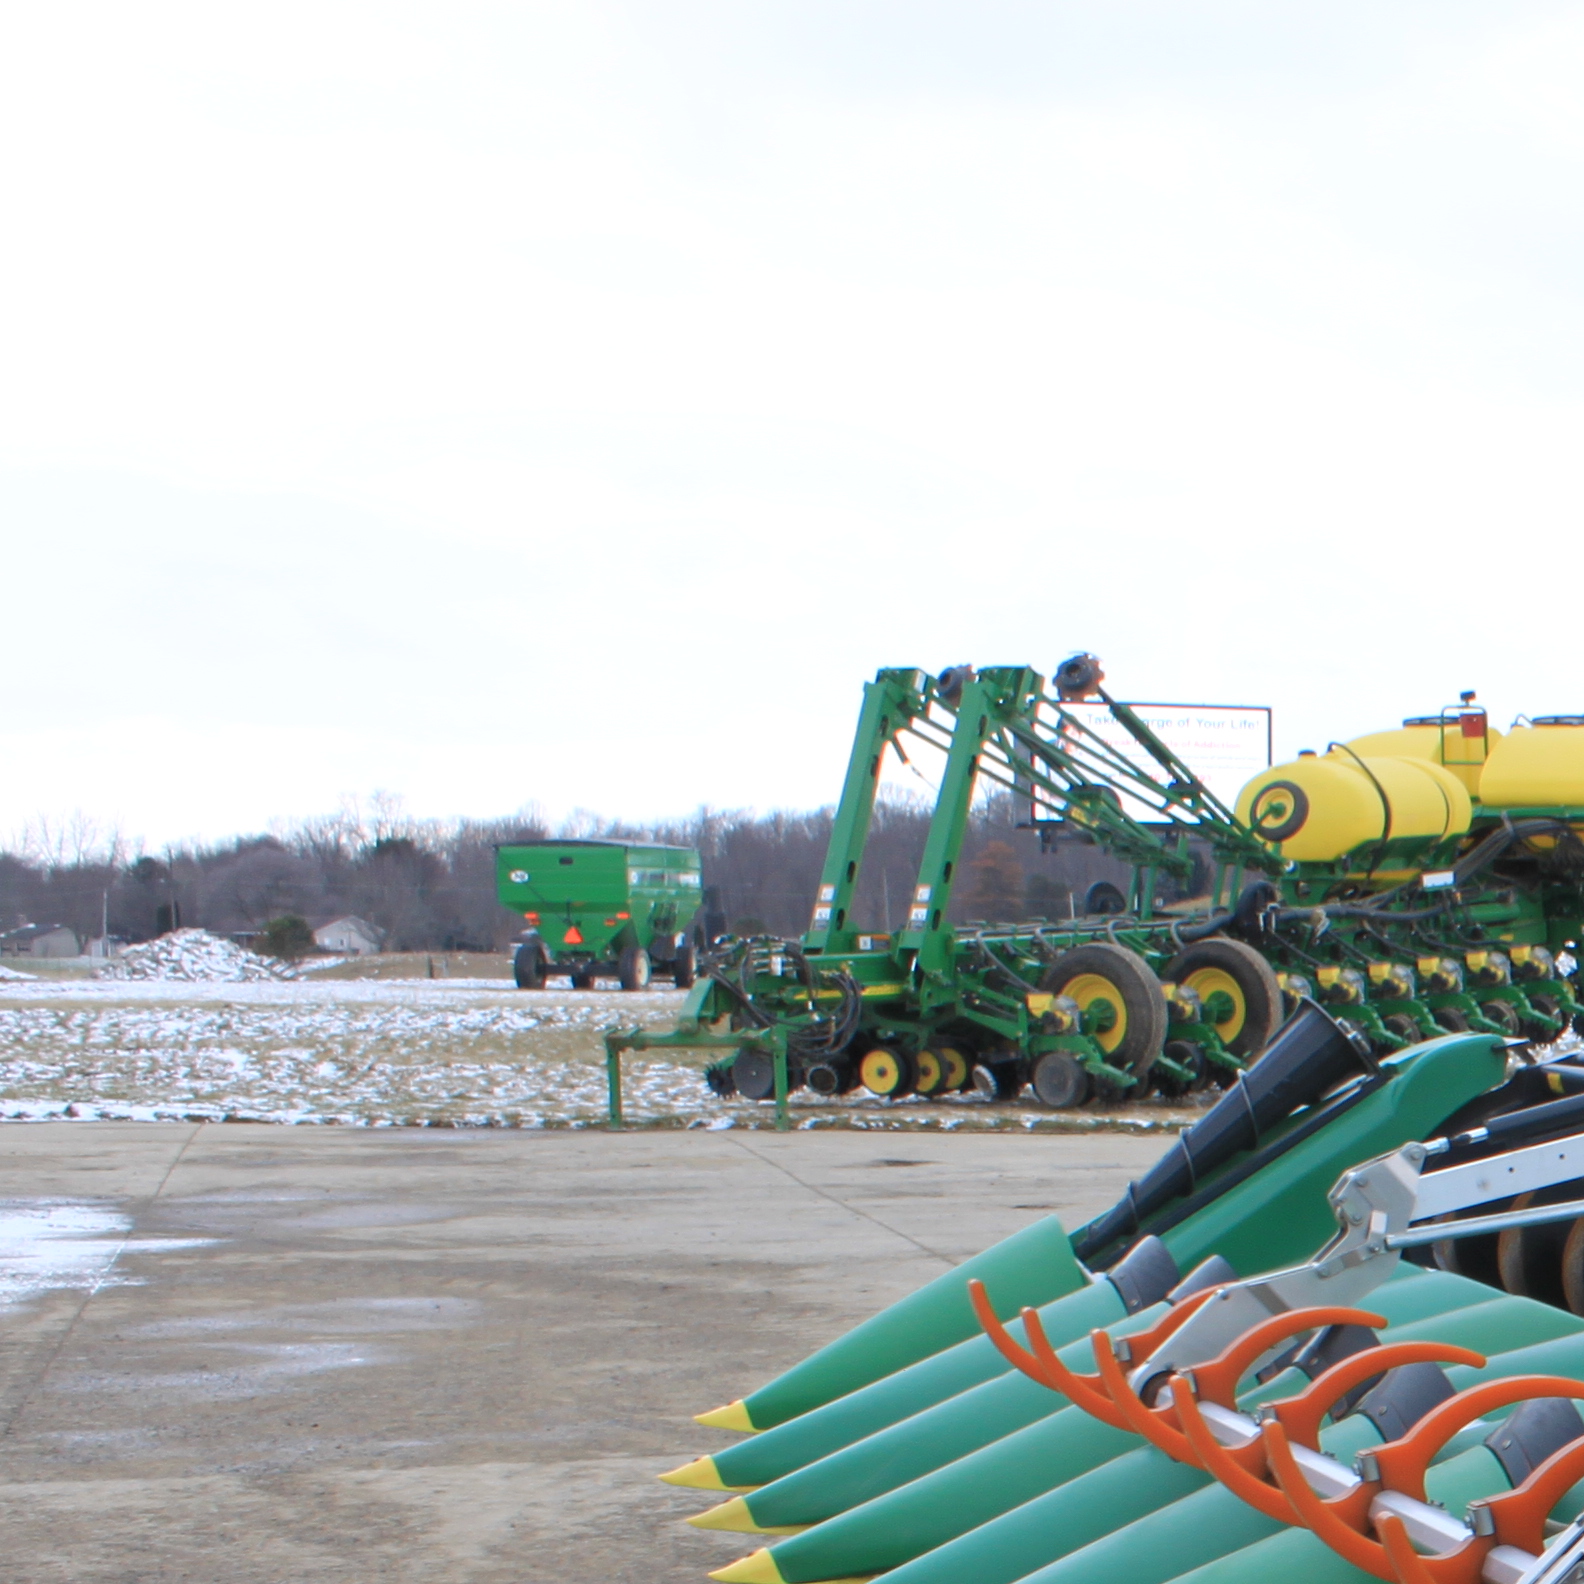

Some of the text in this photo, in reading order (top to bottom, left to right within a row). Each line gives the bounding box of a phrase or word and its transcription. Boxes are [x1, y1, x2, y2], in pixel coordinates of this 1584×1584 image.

[1178, 716, 1191, 728] of
[1196, 718, 1226, 729] Your
[1231, 719, 1260, 730] Life!
